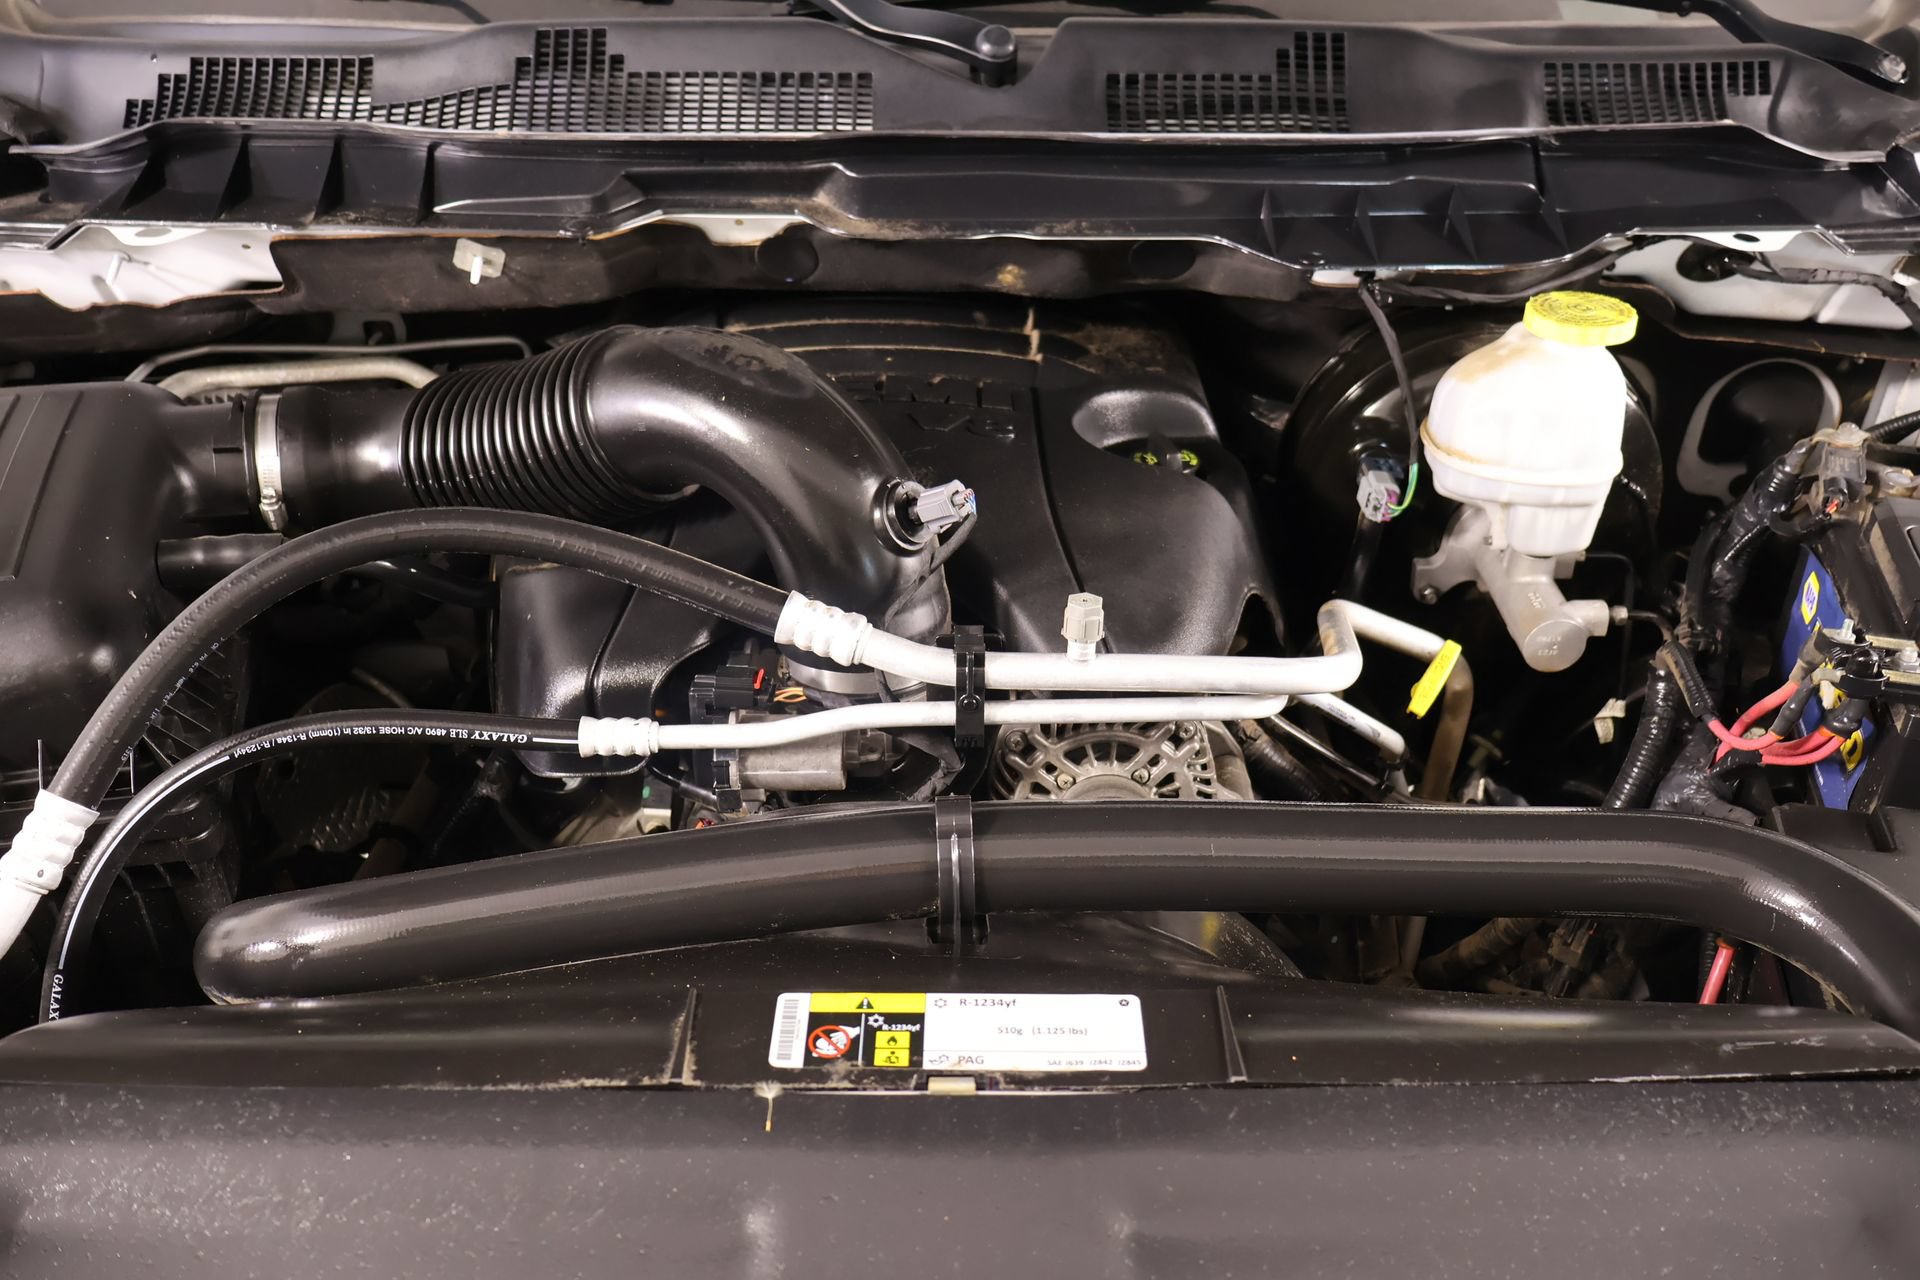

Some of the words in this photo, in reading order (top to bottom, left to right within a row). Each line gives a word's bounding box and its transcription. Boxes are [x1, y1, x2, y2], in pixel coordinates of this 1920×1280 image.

[308, 726, 341, 740] (10mm)
[352, 726, 377, 735] 13/32
[378, 726, 405, 735] HOSE
[407, 726, 423, 735] A/C
[425, 727, 447, 737] 4890
[449, 728, 469, 739] SLE
[276, 732, 307, 744] R-134a
[470, 730, 528, 744] GALAXY
[233, 740, 271, 759] R-1234yf
[48, 974, 64, 1022] GALAX
[959, 998, 1017, 1009] R-1234yf
[882, 1023, 920, 1032] R-1234yf
[997, 1026, 1023, 1036] 510g
[1031, 1026, 1066, 1036] (1.125
[1068, 1026, 1088, 1037] lbs)
[957, 1055, 985, 1065] PAG
